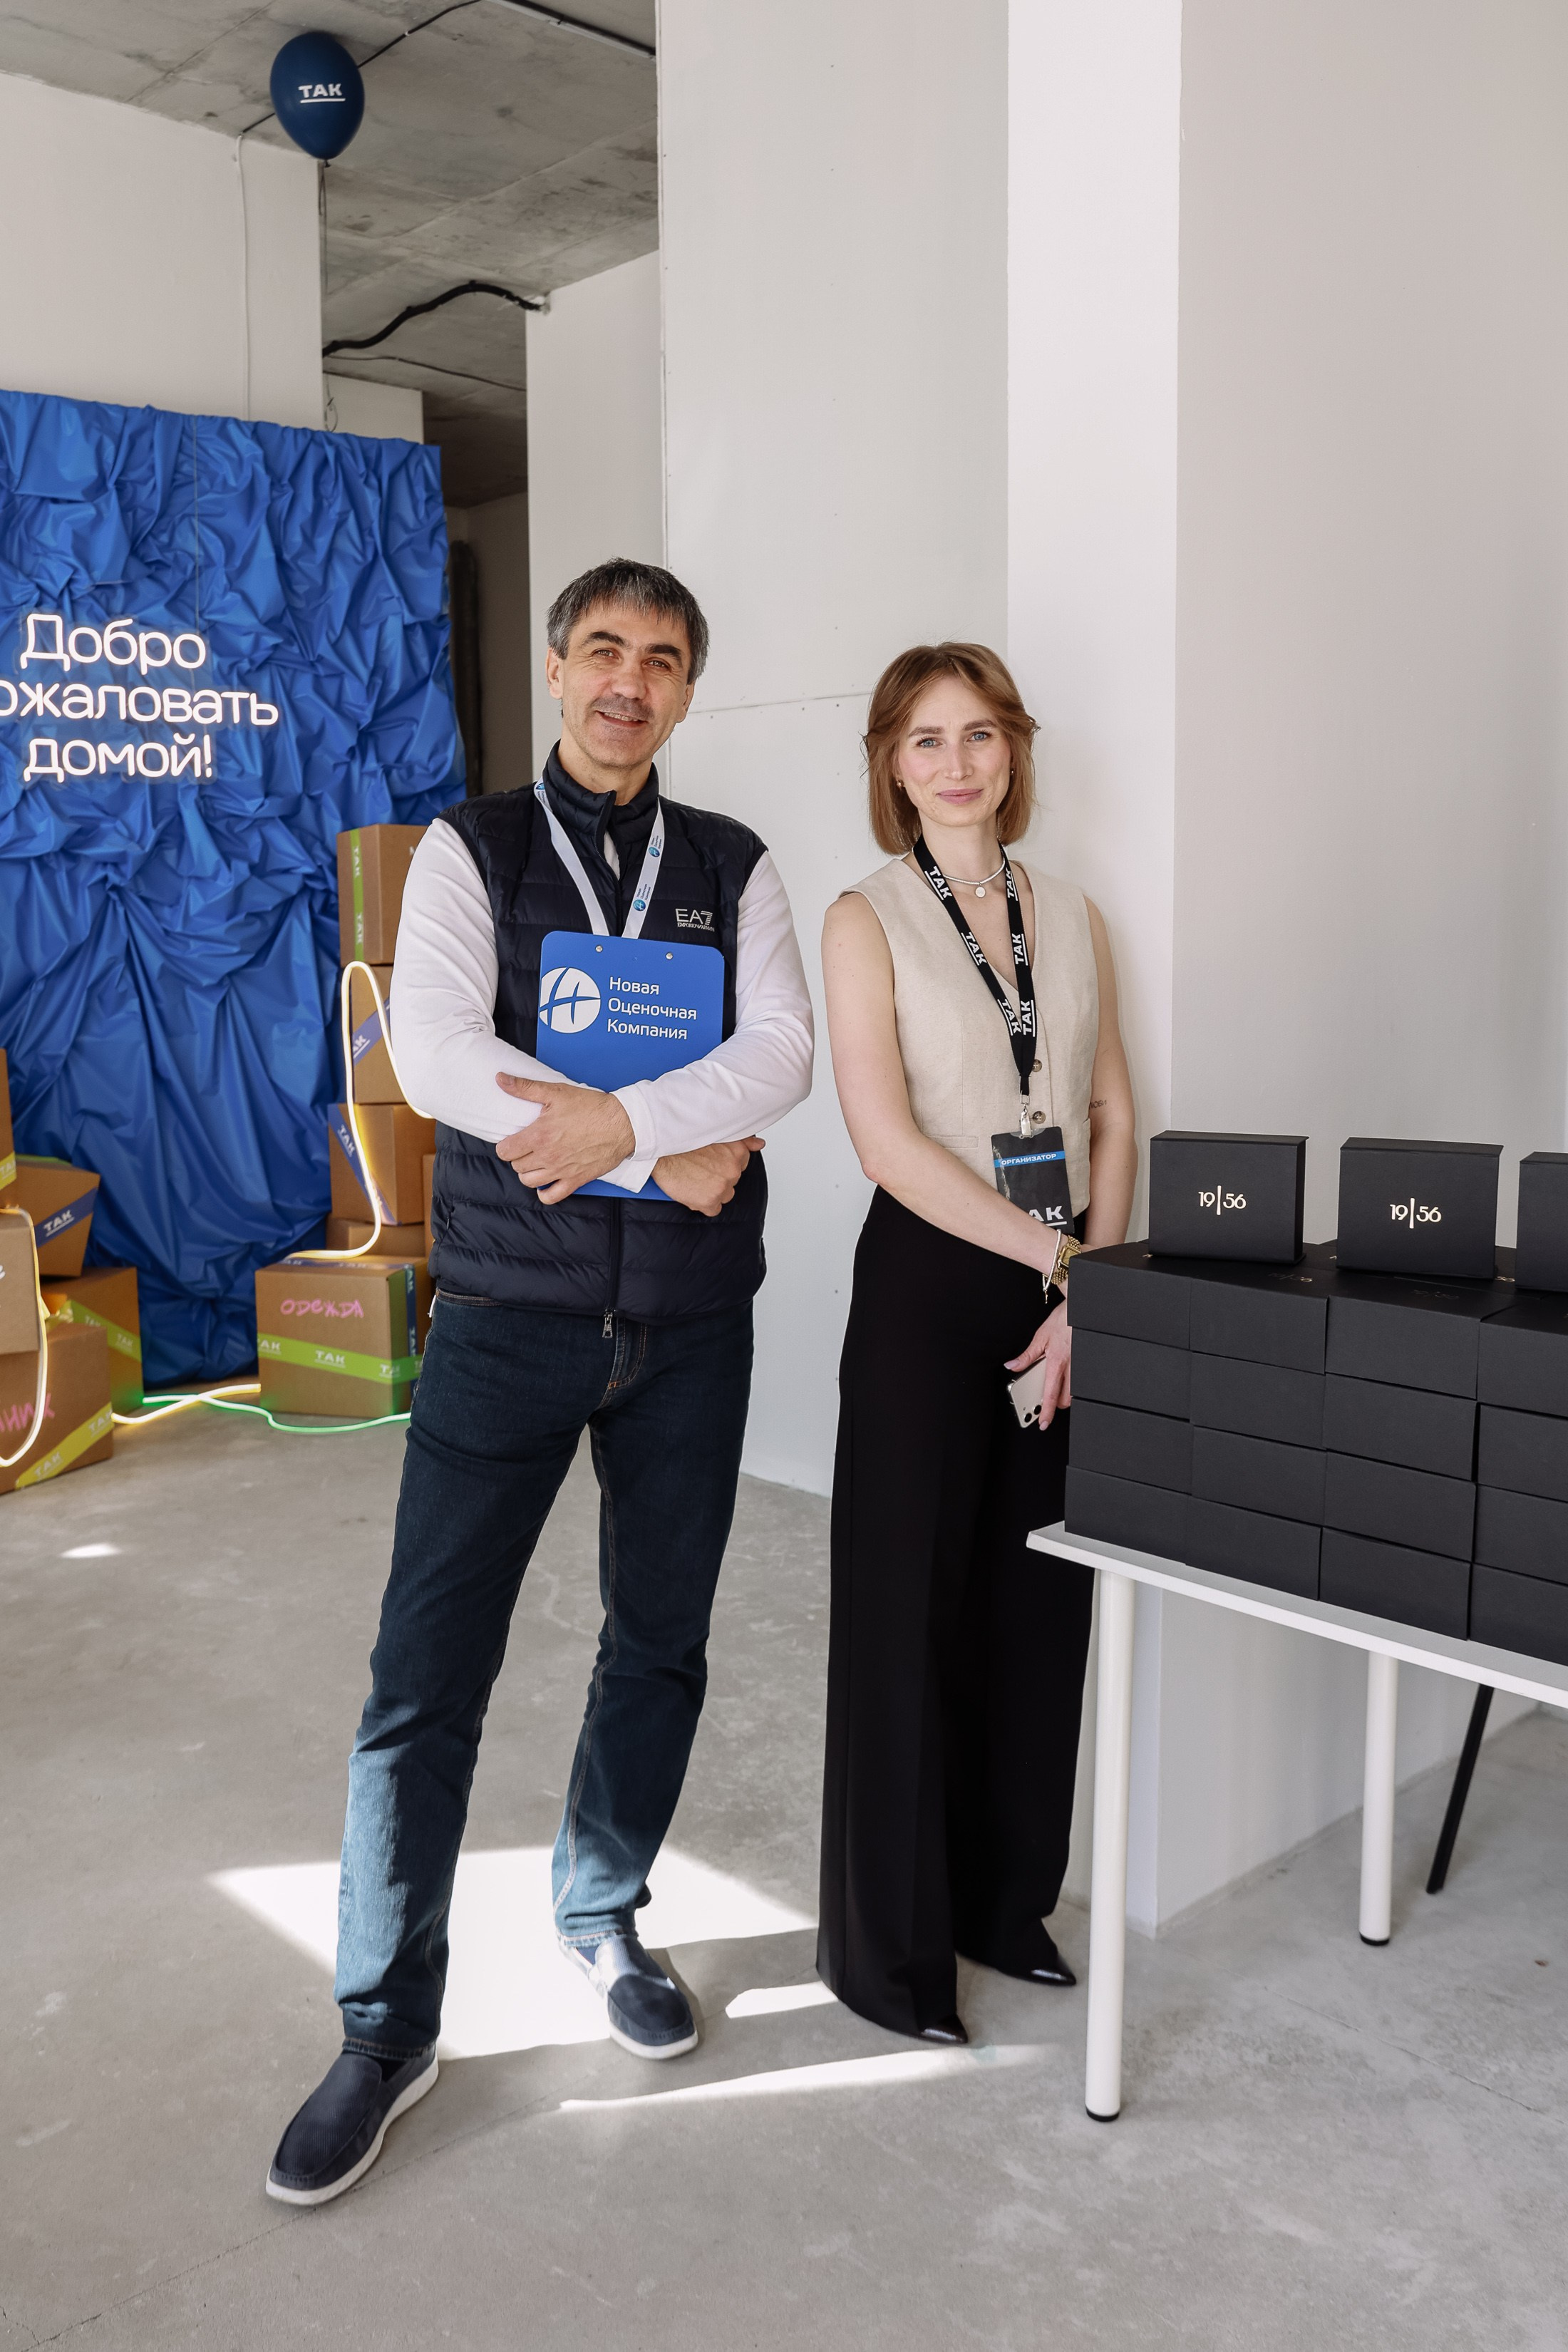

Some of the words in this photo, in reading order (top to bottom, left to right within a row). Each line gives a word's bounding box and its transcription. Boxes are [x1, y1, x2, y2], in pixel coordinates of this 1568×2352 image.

[298, 83, 343, 98] ТАК
[19, 613, 207, 676] Добро
[23, 733, 213, 783] домой!
[929, 865, 953, 899] ТАК
[1006, 867, 1015, 899] ТАК
[675, 908, 713, 926] EA7
[964, 932, 988, 965] ТАК
[1011, 932, 1025, 965] ТАК
[609, 976, 659, 995] Новая
[608, 997, 697, 1021] Оценочная
[1001, 999, 1023, 1034] ТАК
[1020, 1000, 1032, 1036] ТАК
[607, 1018, 688, 1040] Компания
[1001, 1153, 1057, 1165] ОРГАНИЗАТОР
[43, 1209, 72, 1232] ТАК
[1028, 1205, 1064, 1222] АК
[257, 1339, 281, 1350] АК
[315, 1350, 346, 1365] ТАК
